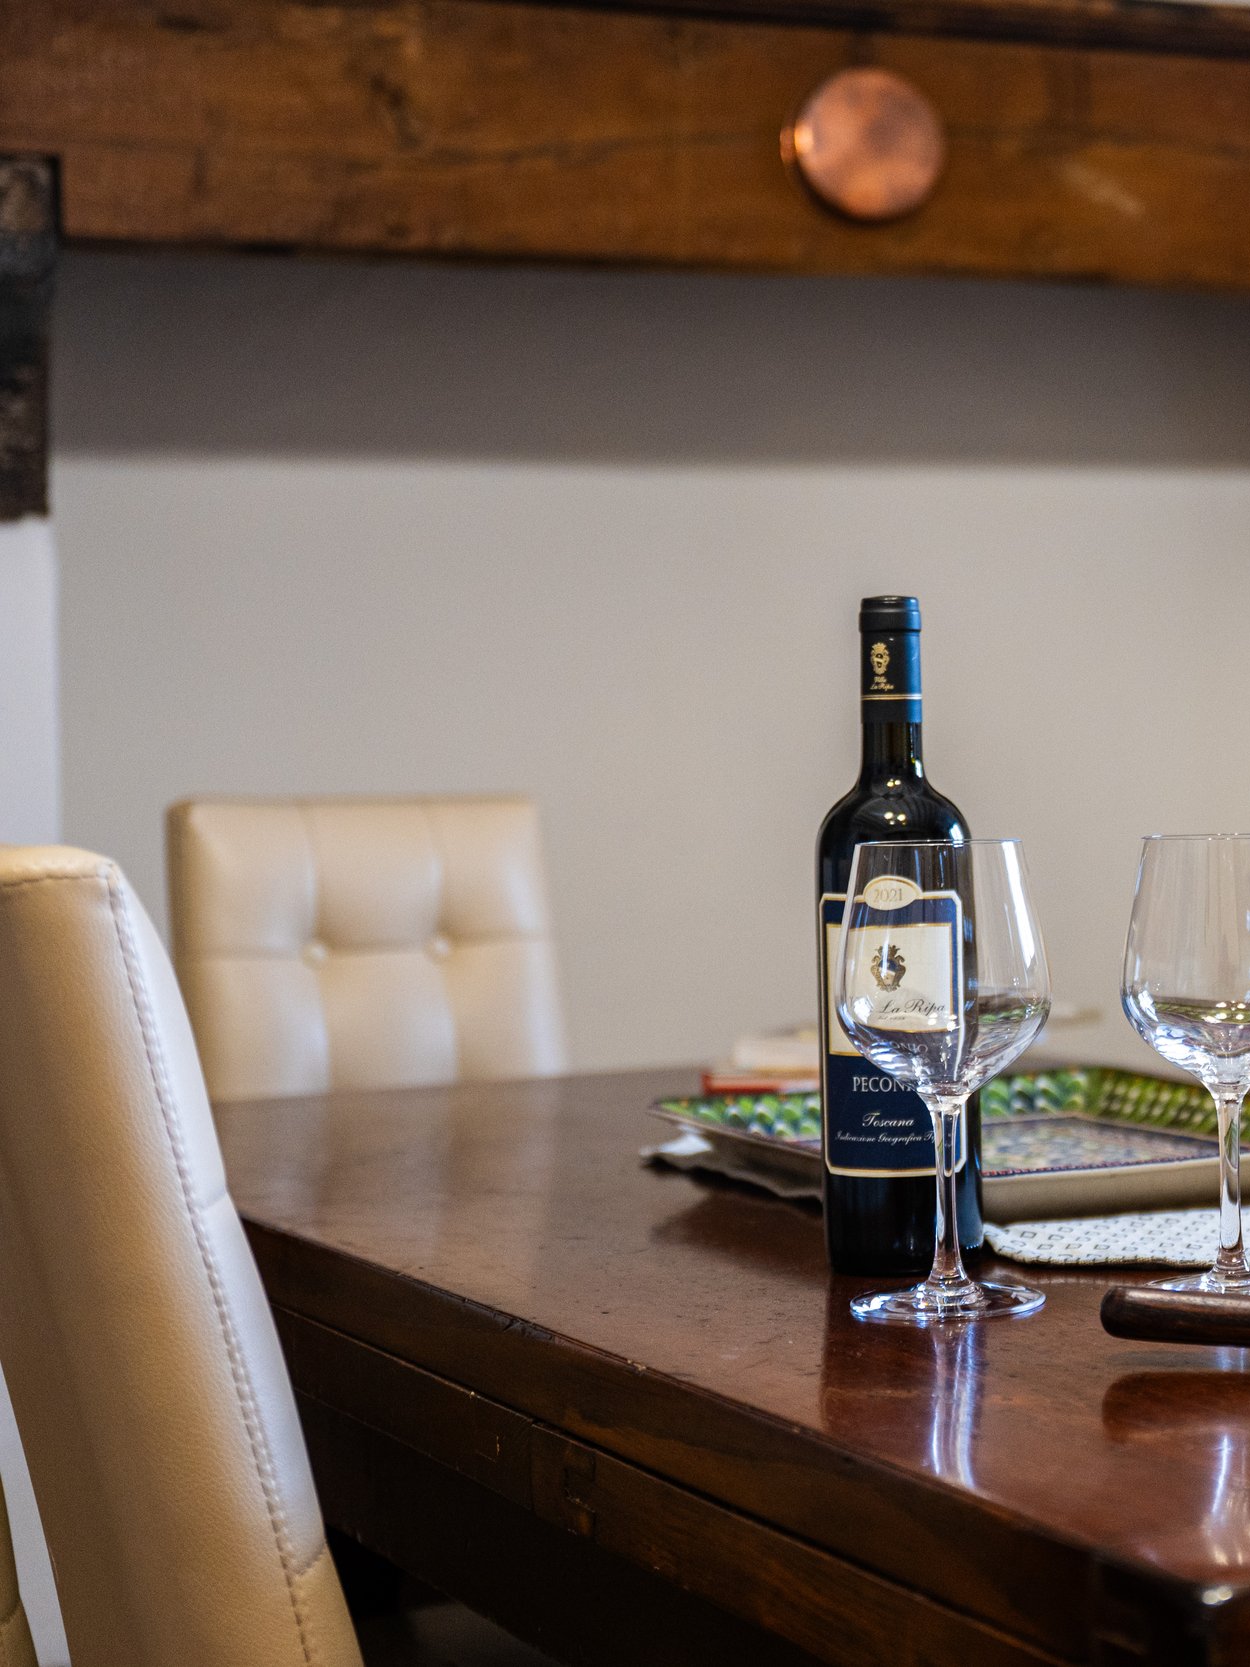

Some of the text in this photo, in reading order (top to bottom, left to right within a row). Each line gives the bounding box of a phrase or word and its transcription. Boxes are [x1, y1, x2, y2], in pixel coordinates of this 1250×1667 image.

[873, 888, 903, 902] 2021
[878, 998, 945, 1017] La Ripa
[852, 1076, 912, 1093] PECON
[862, 1112, 915, 1128] Toscana
[834, 1130, 876, 1143] Indicazione
[877, 1132, 922, 1145] Geografica
